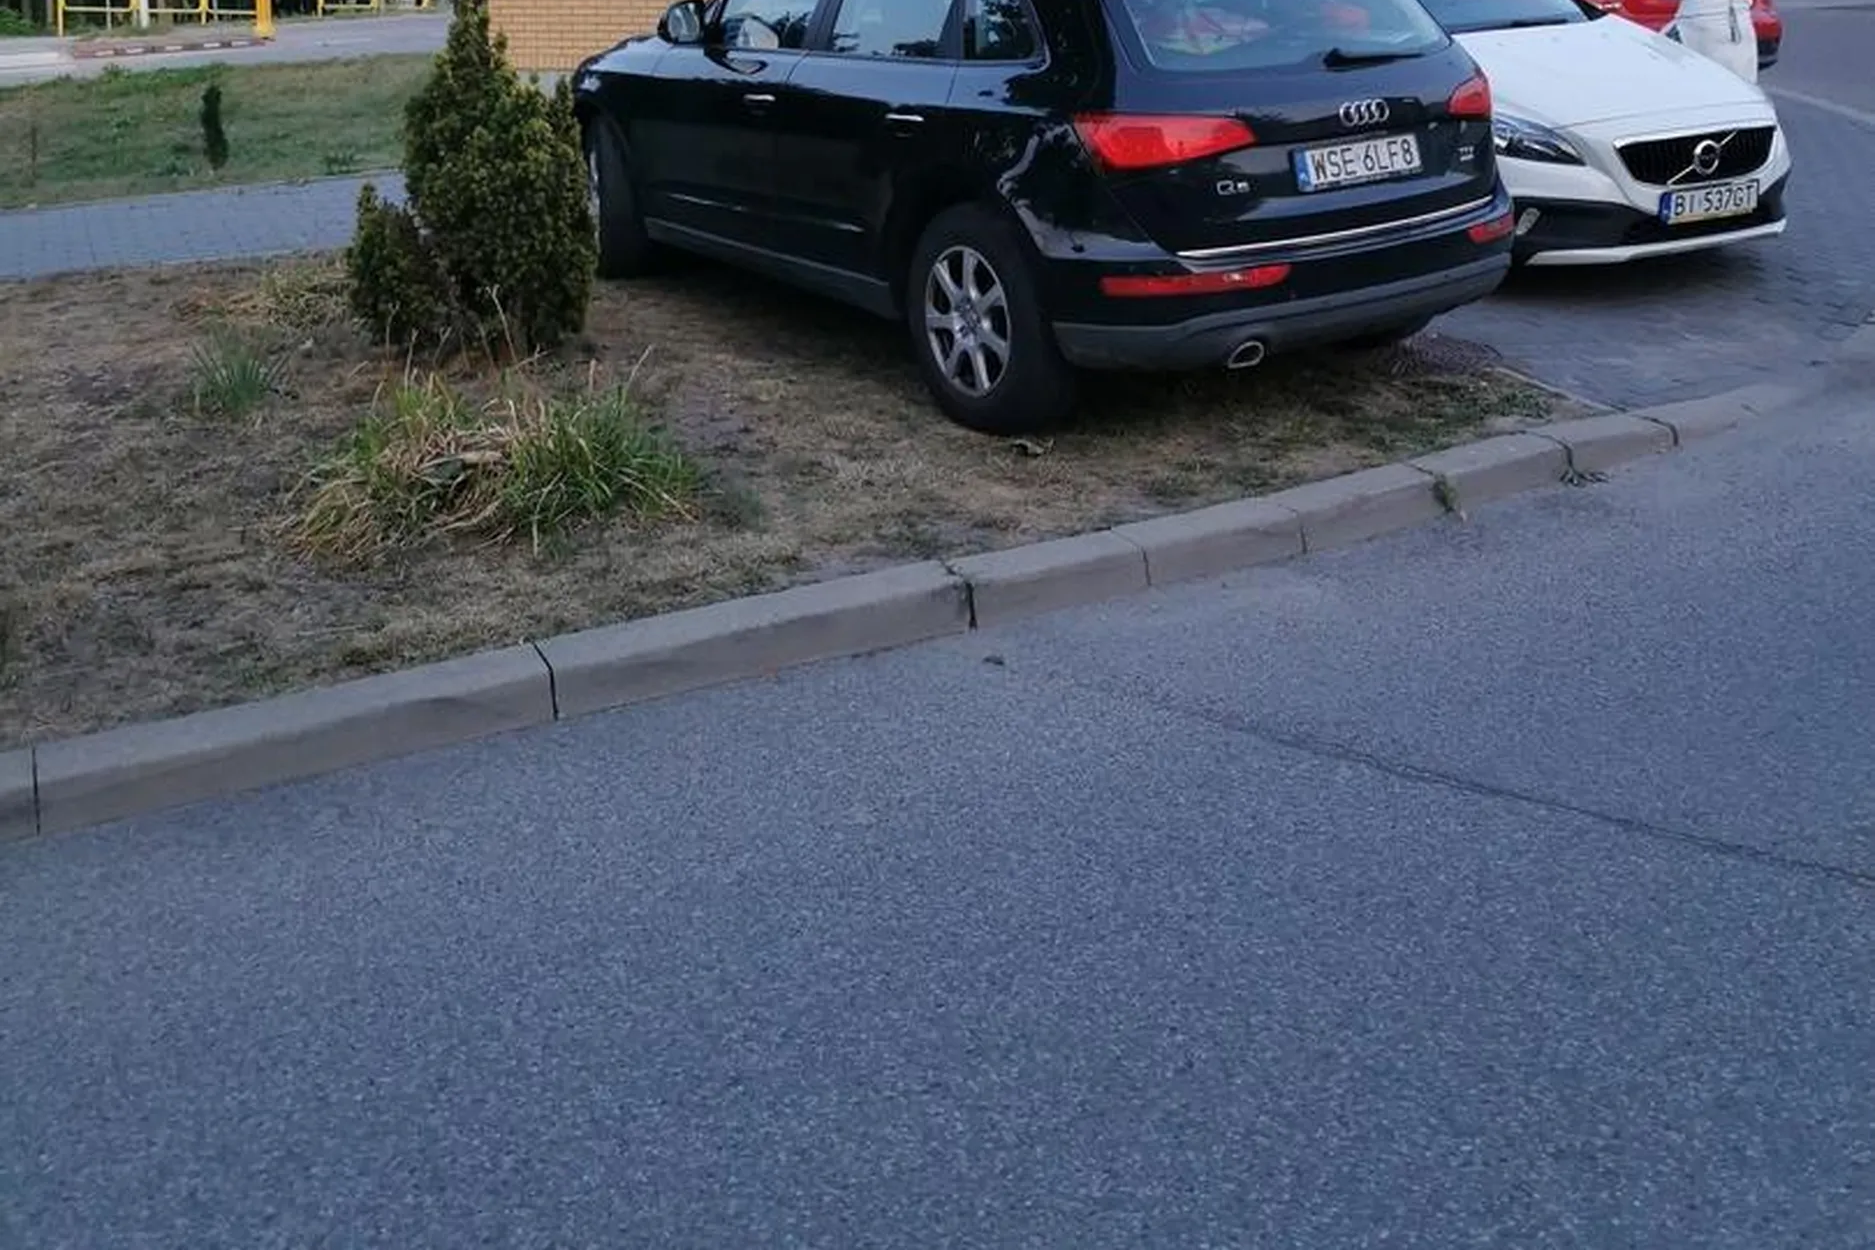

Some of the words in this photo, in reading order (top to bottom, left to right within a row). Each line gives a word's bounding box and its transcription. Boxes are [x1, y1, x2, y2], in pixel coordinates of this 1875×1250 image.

[1310, 147, 1358, 181] WSE
[1362, 137, 1414, 172] 6LF8
[1674, 193, 1696, 216] BI
